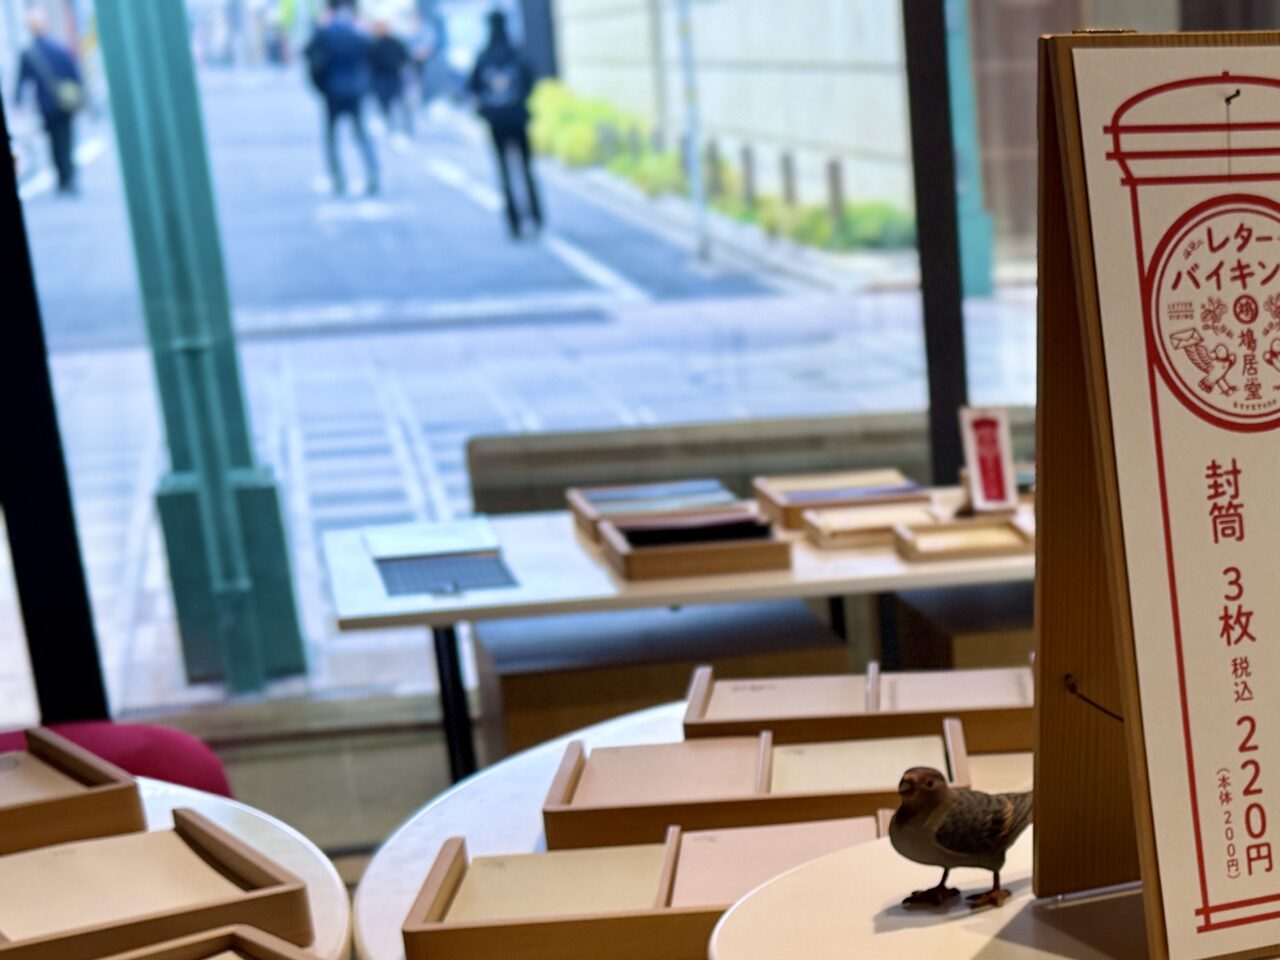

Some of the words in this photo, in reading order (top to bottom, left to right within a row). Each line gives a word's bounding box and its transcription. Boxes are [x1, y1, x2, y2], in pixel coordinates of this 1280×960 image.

[1207, 222, 1273, 253] レター
[1237, 327, 1263, 400] 鳩居堂
[1205, 457, 1245, 544] 封筒
[1218, 566, 1257, 646] 3枚
[1231, 656, 1254, 703] 税込
[1236, 715, 1274, 876] 220円
